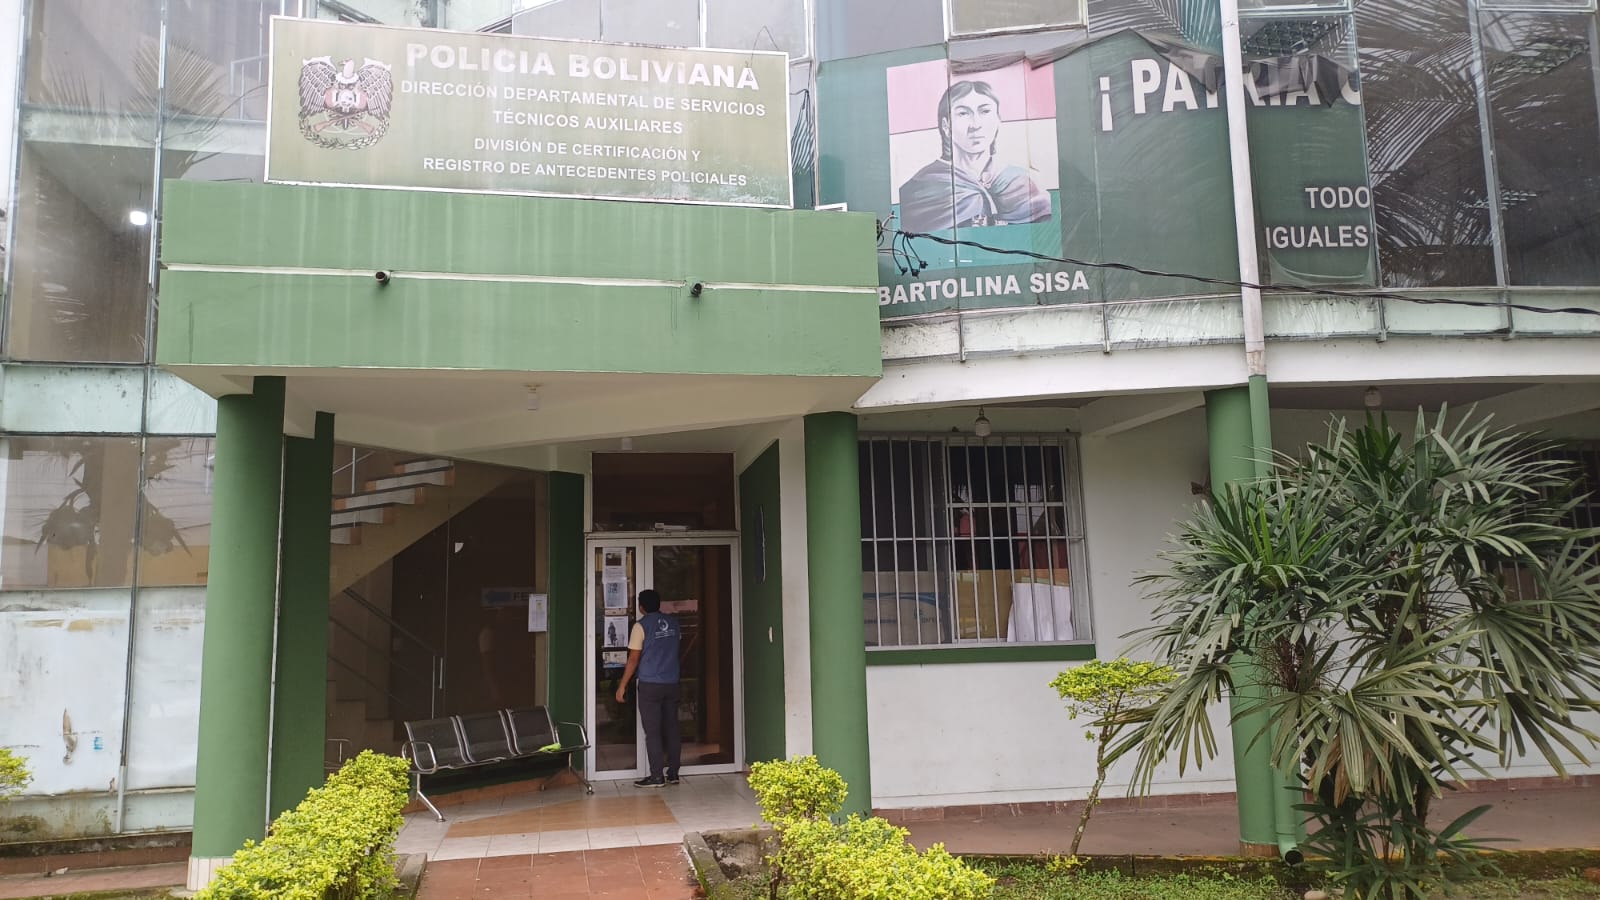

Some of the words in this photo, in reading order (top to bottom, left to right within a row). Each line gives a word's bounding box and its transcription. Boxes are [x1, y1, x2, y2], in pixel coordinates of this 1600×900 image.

[406, 43, 555, 76] POLICIA
[569, 54, 759, 90] BOLIVIANA
[401, 80, 497, 98] DIRECCIÓN
[503, 86, 648, 108] DEPARTAMENTAL
[653, 96, 675, 110] DE
[680, 98, 766, 117] SERVICIOS
[493, 108, 579, 128] TÉCNICOS
[584, 117, 683, 134] AUXILIARES
[474, 138, 542, 153] DIVISIÓN
[547, 142, 567, 154] DE
[572, 143, 687, 161] CERTIFICACIÓN
[691, 150, 702, 161] Y
[423, 157, 504, 174] REGISTRO
[510, 162, 531, 175] DE
[535, 164, 656, 181] ANTECEDENTES
[661, 171, 747, 186] POLICIALES
[1305, 186, 1370, 209] TODO
[1266, 225, 1369, 249] IGUALES
[878, 275, 1021, 306] BARTOLINA
[1030, 270, 1090, 294] SISA
